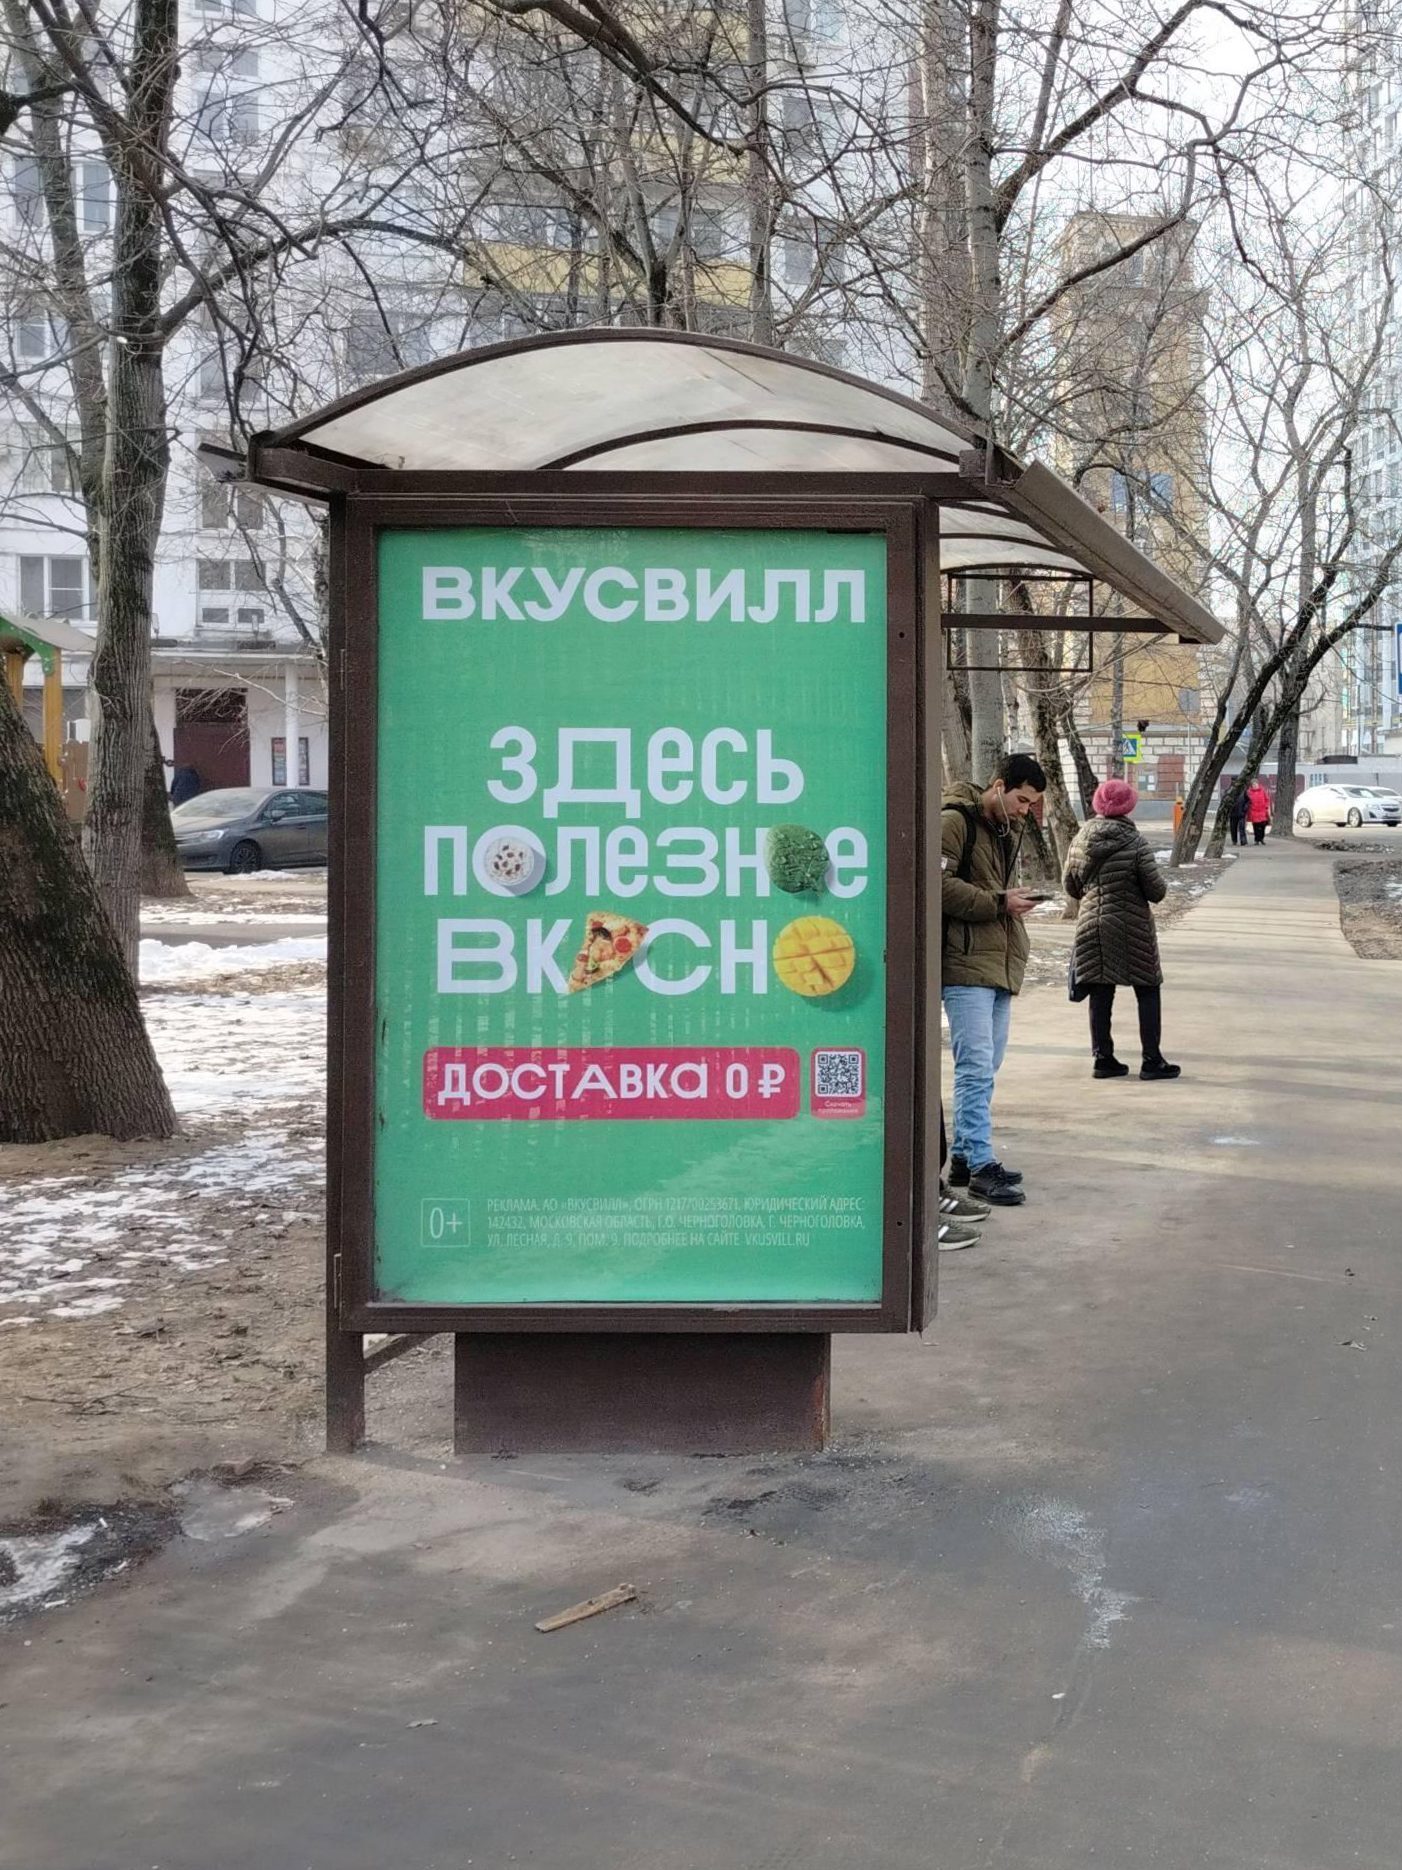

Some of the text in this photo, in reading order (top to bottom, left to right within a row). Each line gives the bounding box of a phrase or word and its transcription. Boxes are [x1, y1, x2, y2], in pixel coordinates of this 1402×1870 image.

[422, 566, 866, 623] ВКУСВИЛЛ
[438, 1062, 708, 1105] ДОСТАВКА
[543, 1198, 558, 1211] АО
[634, 1197, 663, 1211] ОГРН
[744, 1195, 827, 1213] ЮРИДИЧЕСКИЙ
[430, 1208, 463, 1239] 0+
[529, 1215, 602, 1229] МОСКОВСКАЯ
[623, 1232, 687, 1247] ПОДРОБНЕЕ
[690, 1232, 704, 1247] НА
[707, 1229, 739, 1247] САЙТЕ
[745, 1232, 810, 1247] VKUSVILL.RU
